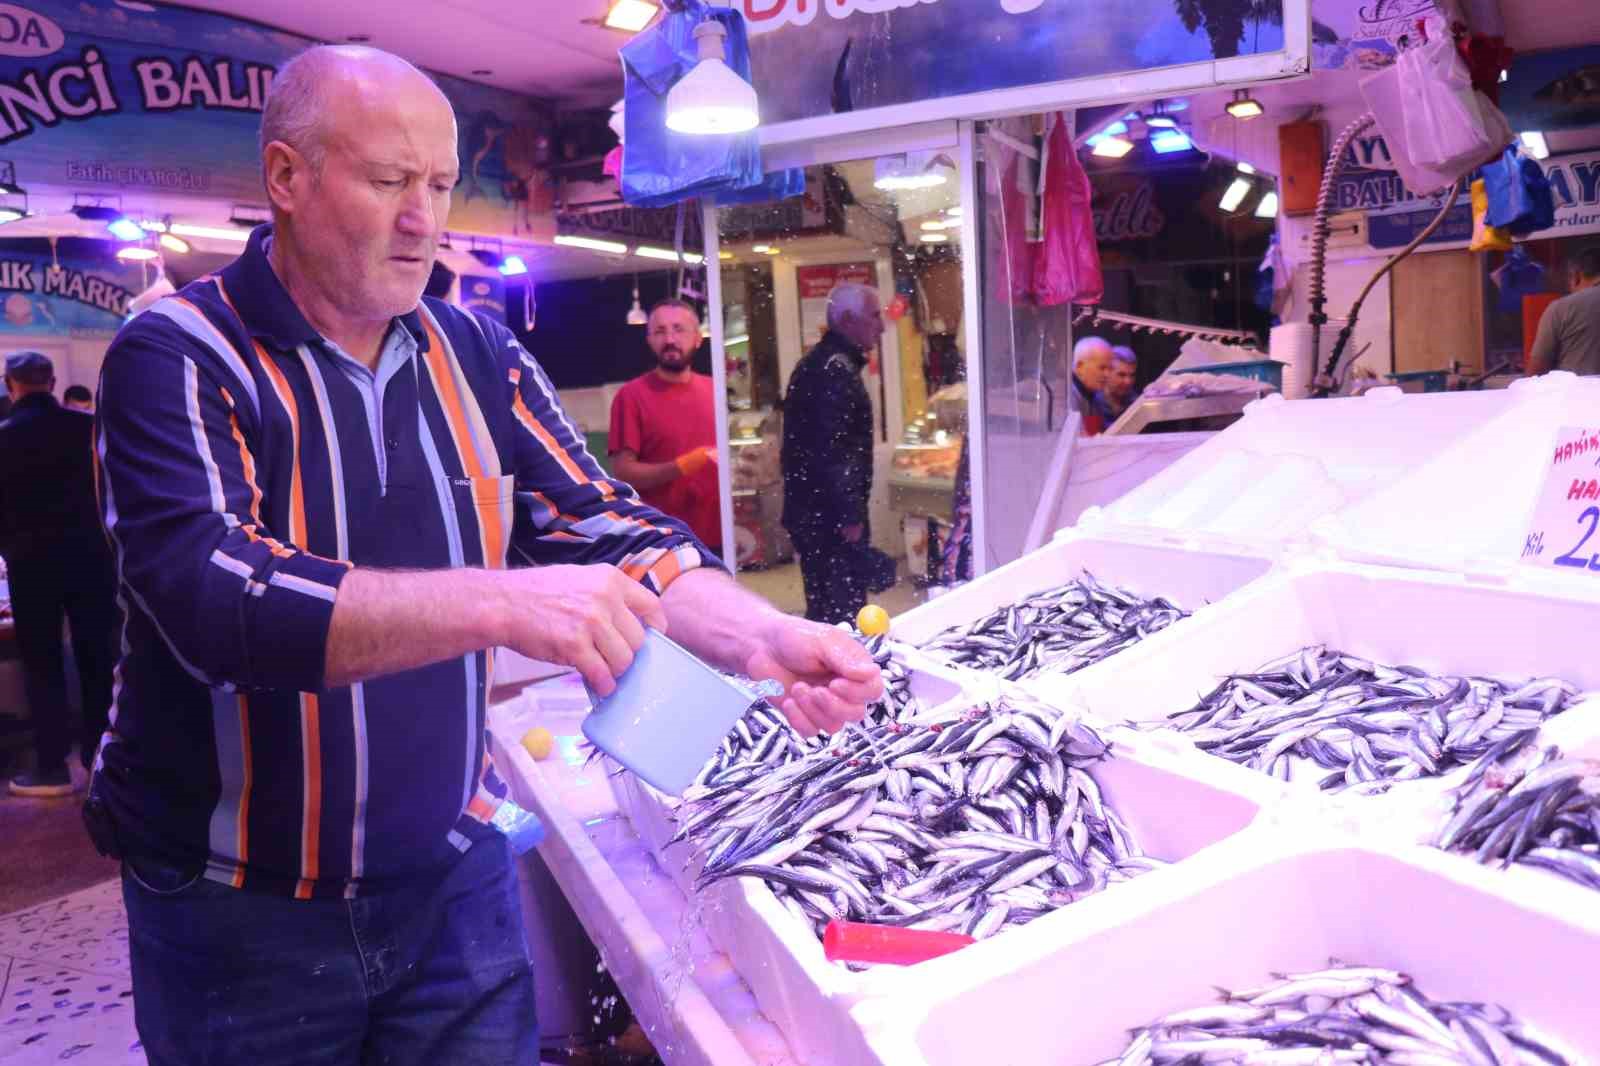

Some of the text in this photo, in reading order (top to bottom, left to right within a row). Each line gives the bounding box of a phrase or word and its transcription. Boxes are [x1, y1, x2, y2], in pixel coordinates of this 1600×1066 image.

[0, 50, 117, 138] NCİ
[0, 261, 32, 290] IK
[1553, 429, 1600, 464] HAKİK
[1567, 479, 1600, 500] HA
[1554, 505, 1600, 572] 2
